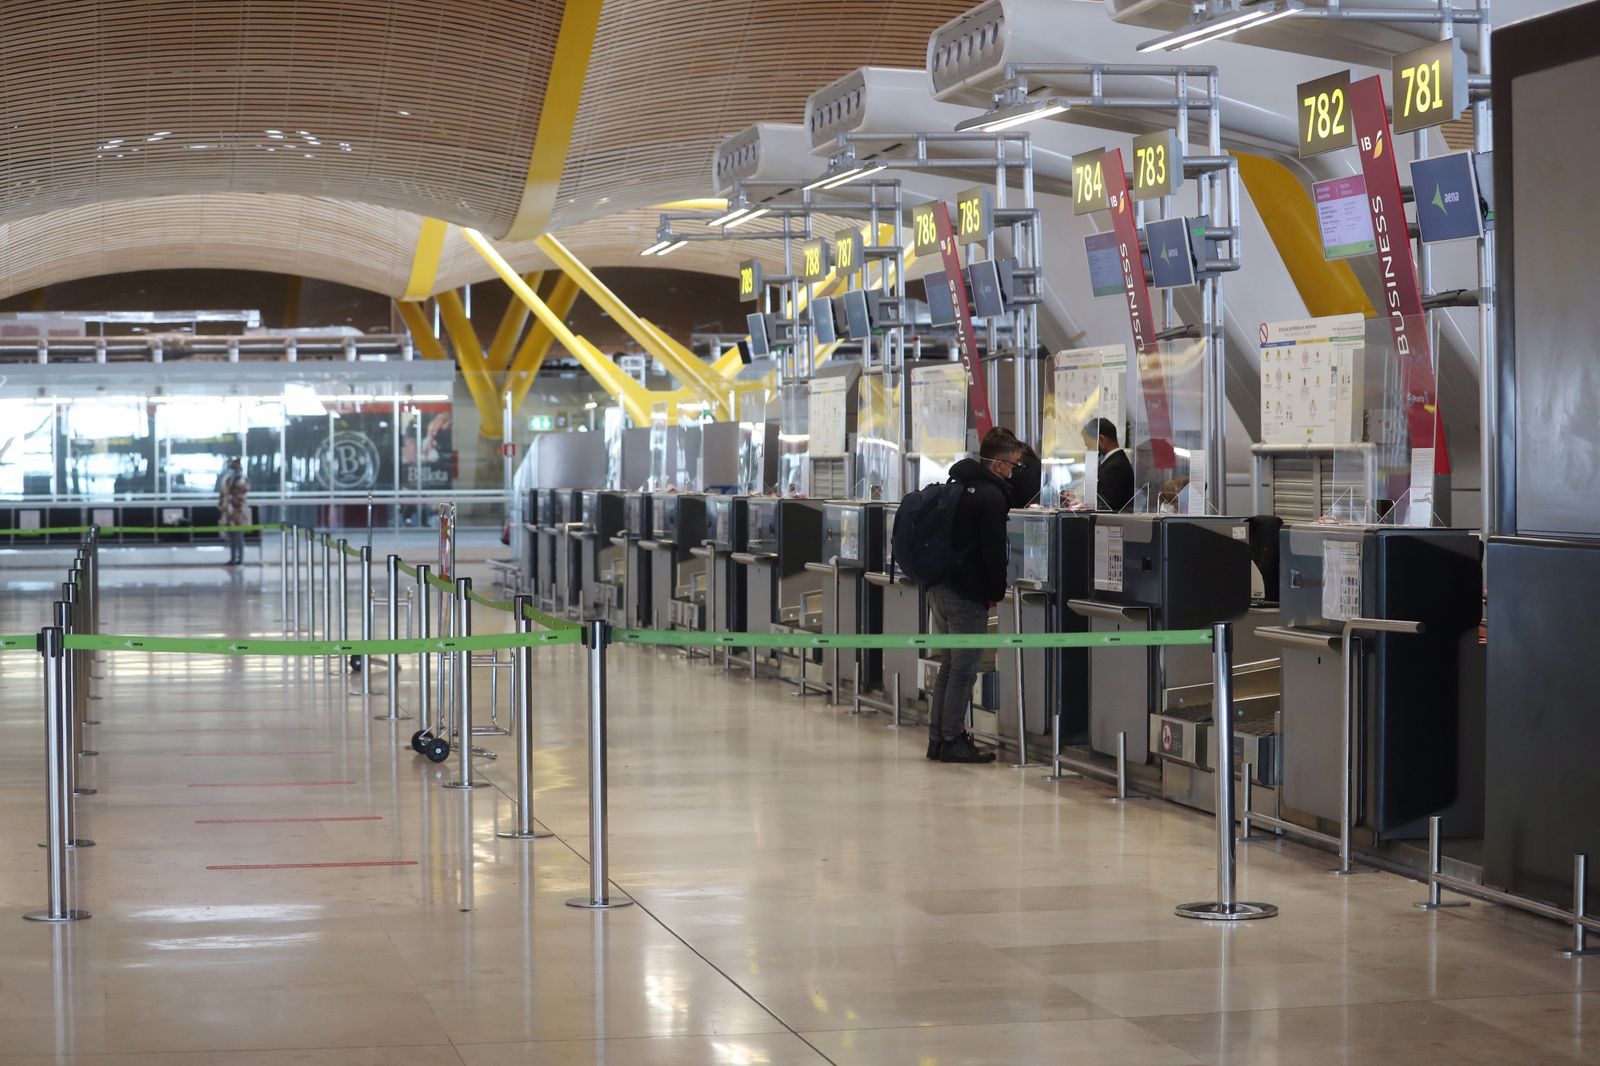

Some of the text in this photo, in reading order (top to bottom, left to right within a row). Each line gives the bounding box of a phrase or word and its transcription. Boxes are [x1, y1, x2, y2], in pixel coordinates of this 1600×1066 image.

[1401, 59, 1442, 117] 781
[1304, 88, 1345, 142] 782
[1360, 136, 1372, 152] IB
[1075, 161, 1103, 204] 784
[1137, 144, 1166, 188] 783
[916, 211, 937, 247] 786
[959, 198, 981, 234] 785
[804, 247, 820, 277] 788
[837, 237, 852, 269] 787
[741, 267, 753, 294] 789
[1372, 195, 1410, 355] BUSINESS
[1120, 243, 1148, 371] BUSINESS
[949, 279, 974, 386] BUSINESS
